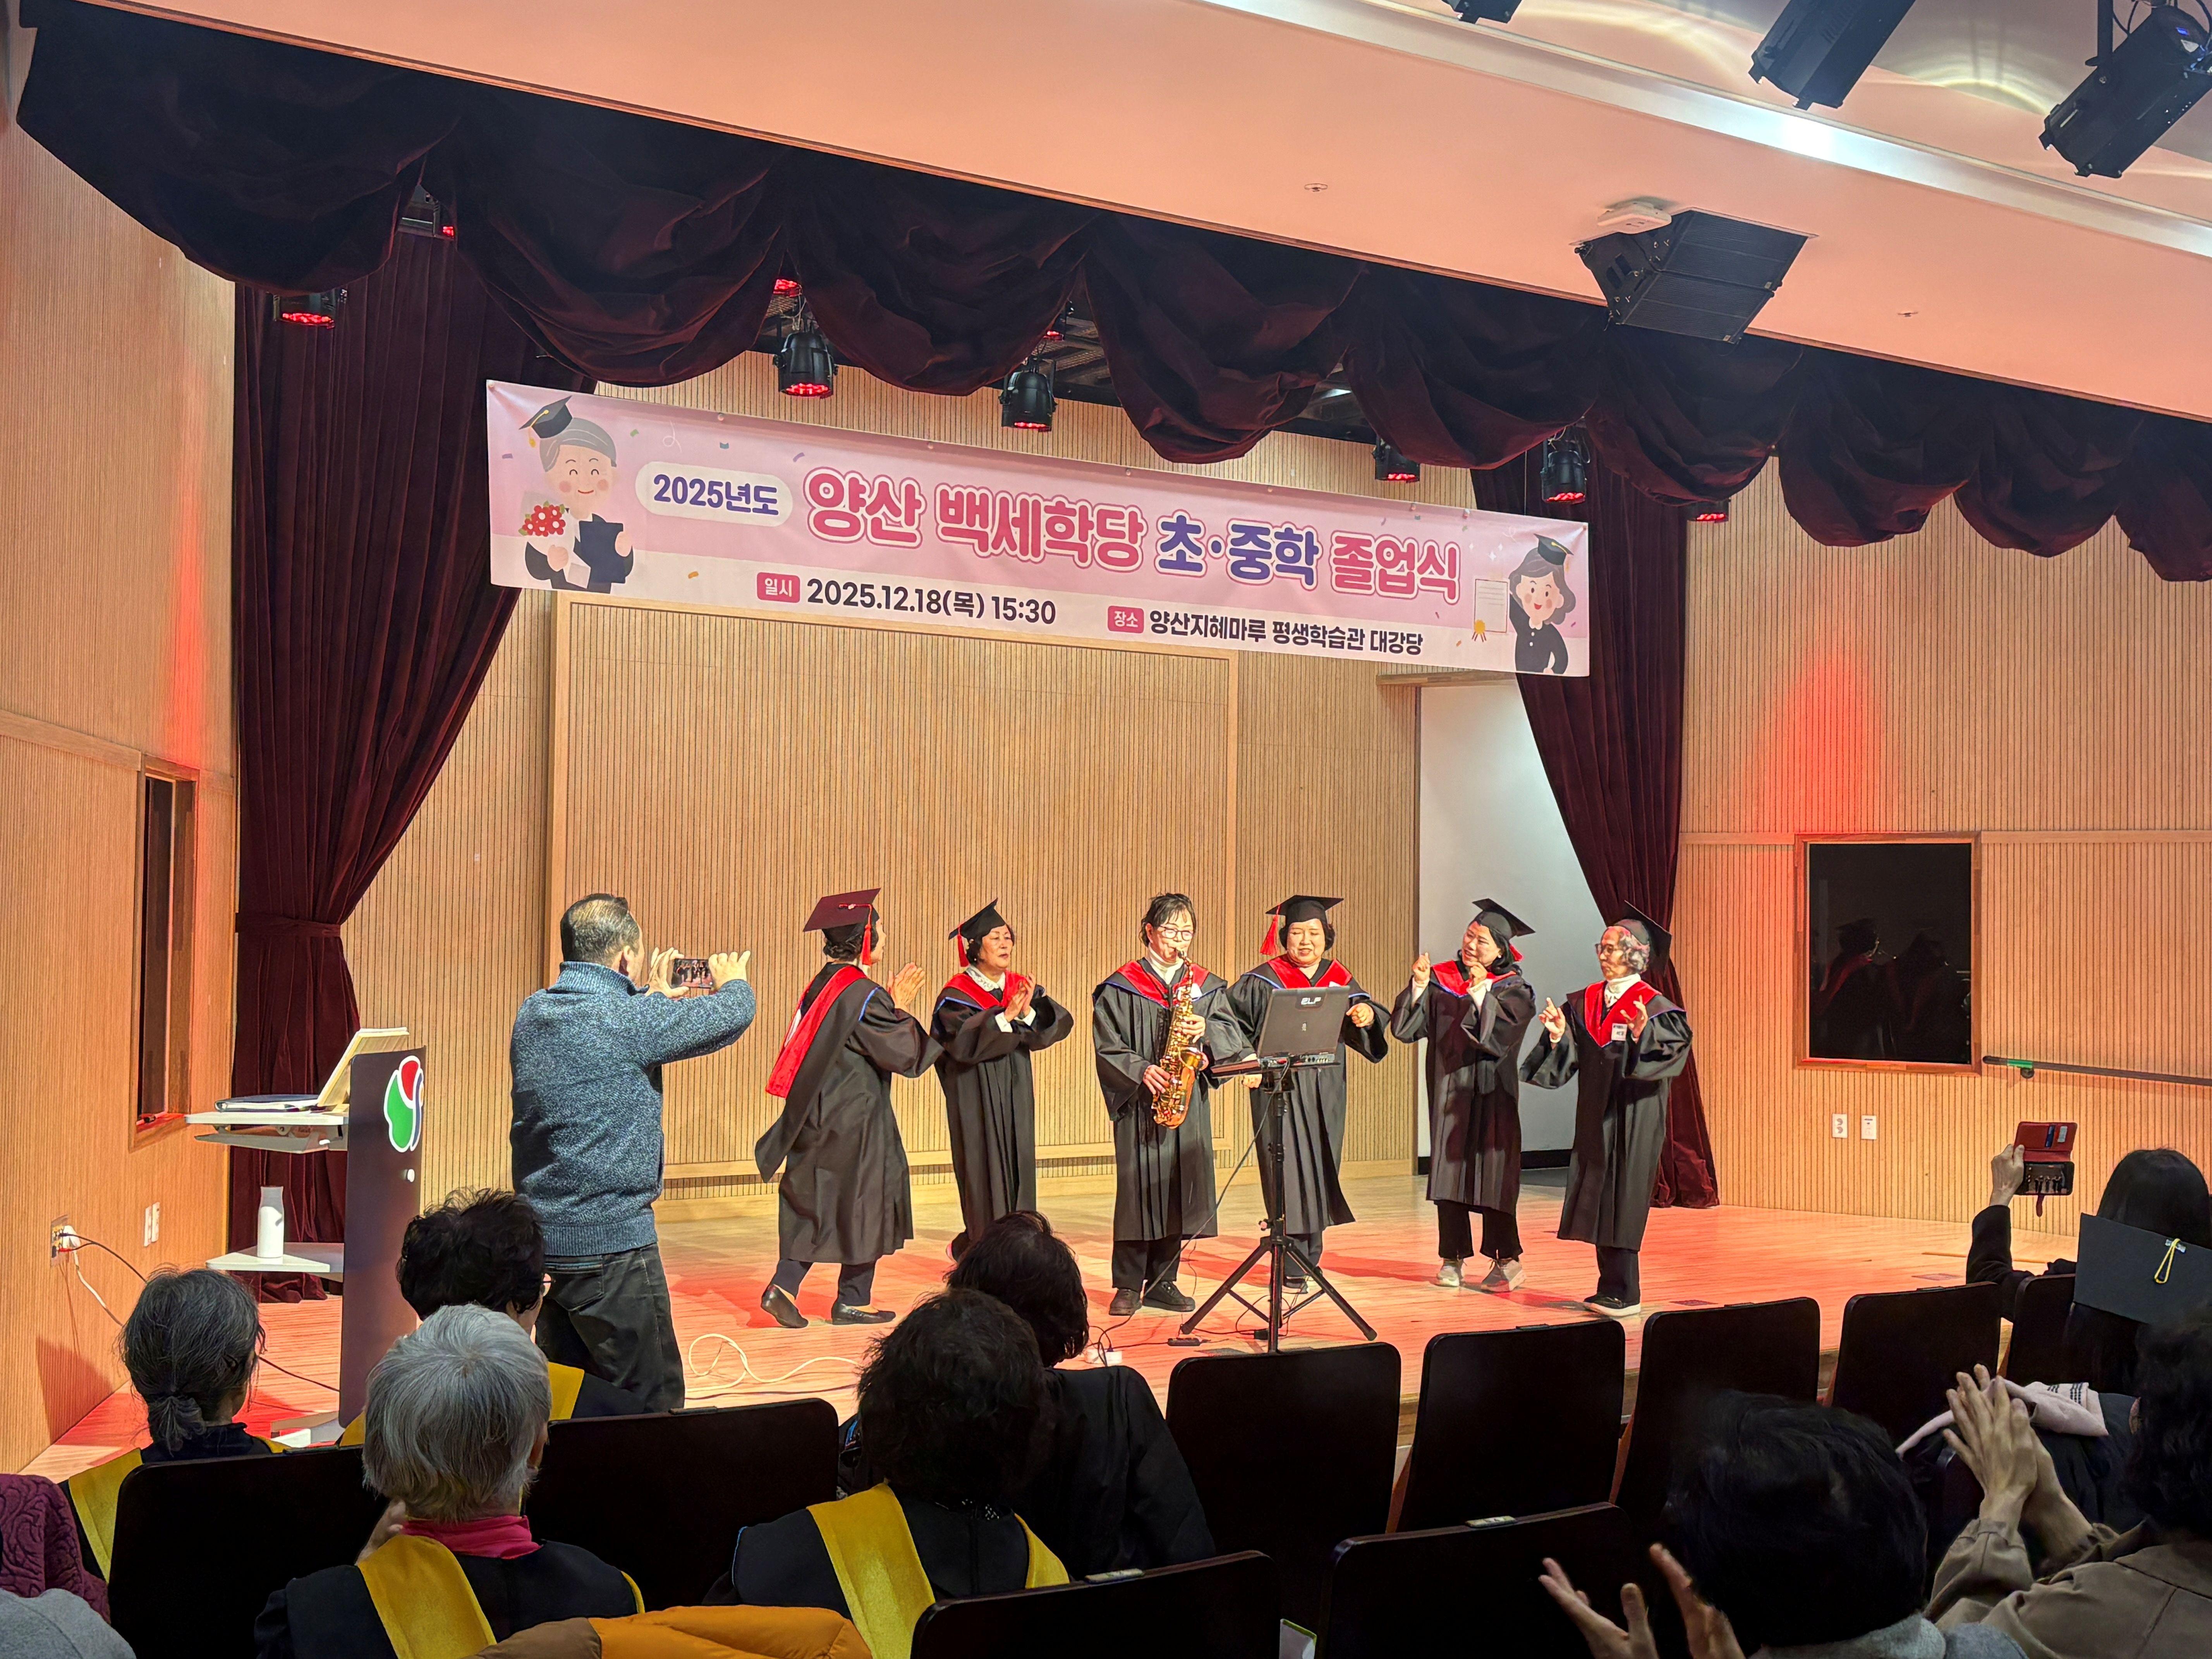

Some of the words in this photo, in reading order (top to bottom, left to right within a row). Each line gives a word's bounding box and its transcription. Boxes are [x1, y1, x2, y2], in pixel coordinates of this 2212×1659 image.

[653, 474, 779, 515] 2025년도
[807, 470, 925, 546] 양산
[937, 485, 1146, 570] 백세학당
[1331, 532, 1460, 603] 졸업식
[764, 579, 793, 598] 일시
[807, 579, 984, 619] 2025.12.18(목)
[992, 596, 1056, 625] 15:30
[1114, 611, 1139, 629] 장소
[1149, 610, 1267, 642] 양산지혜마루
[1273, 620, 1365, 651] 평생학습관
[1370, 630, 1424, 656] 대강당
